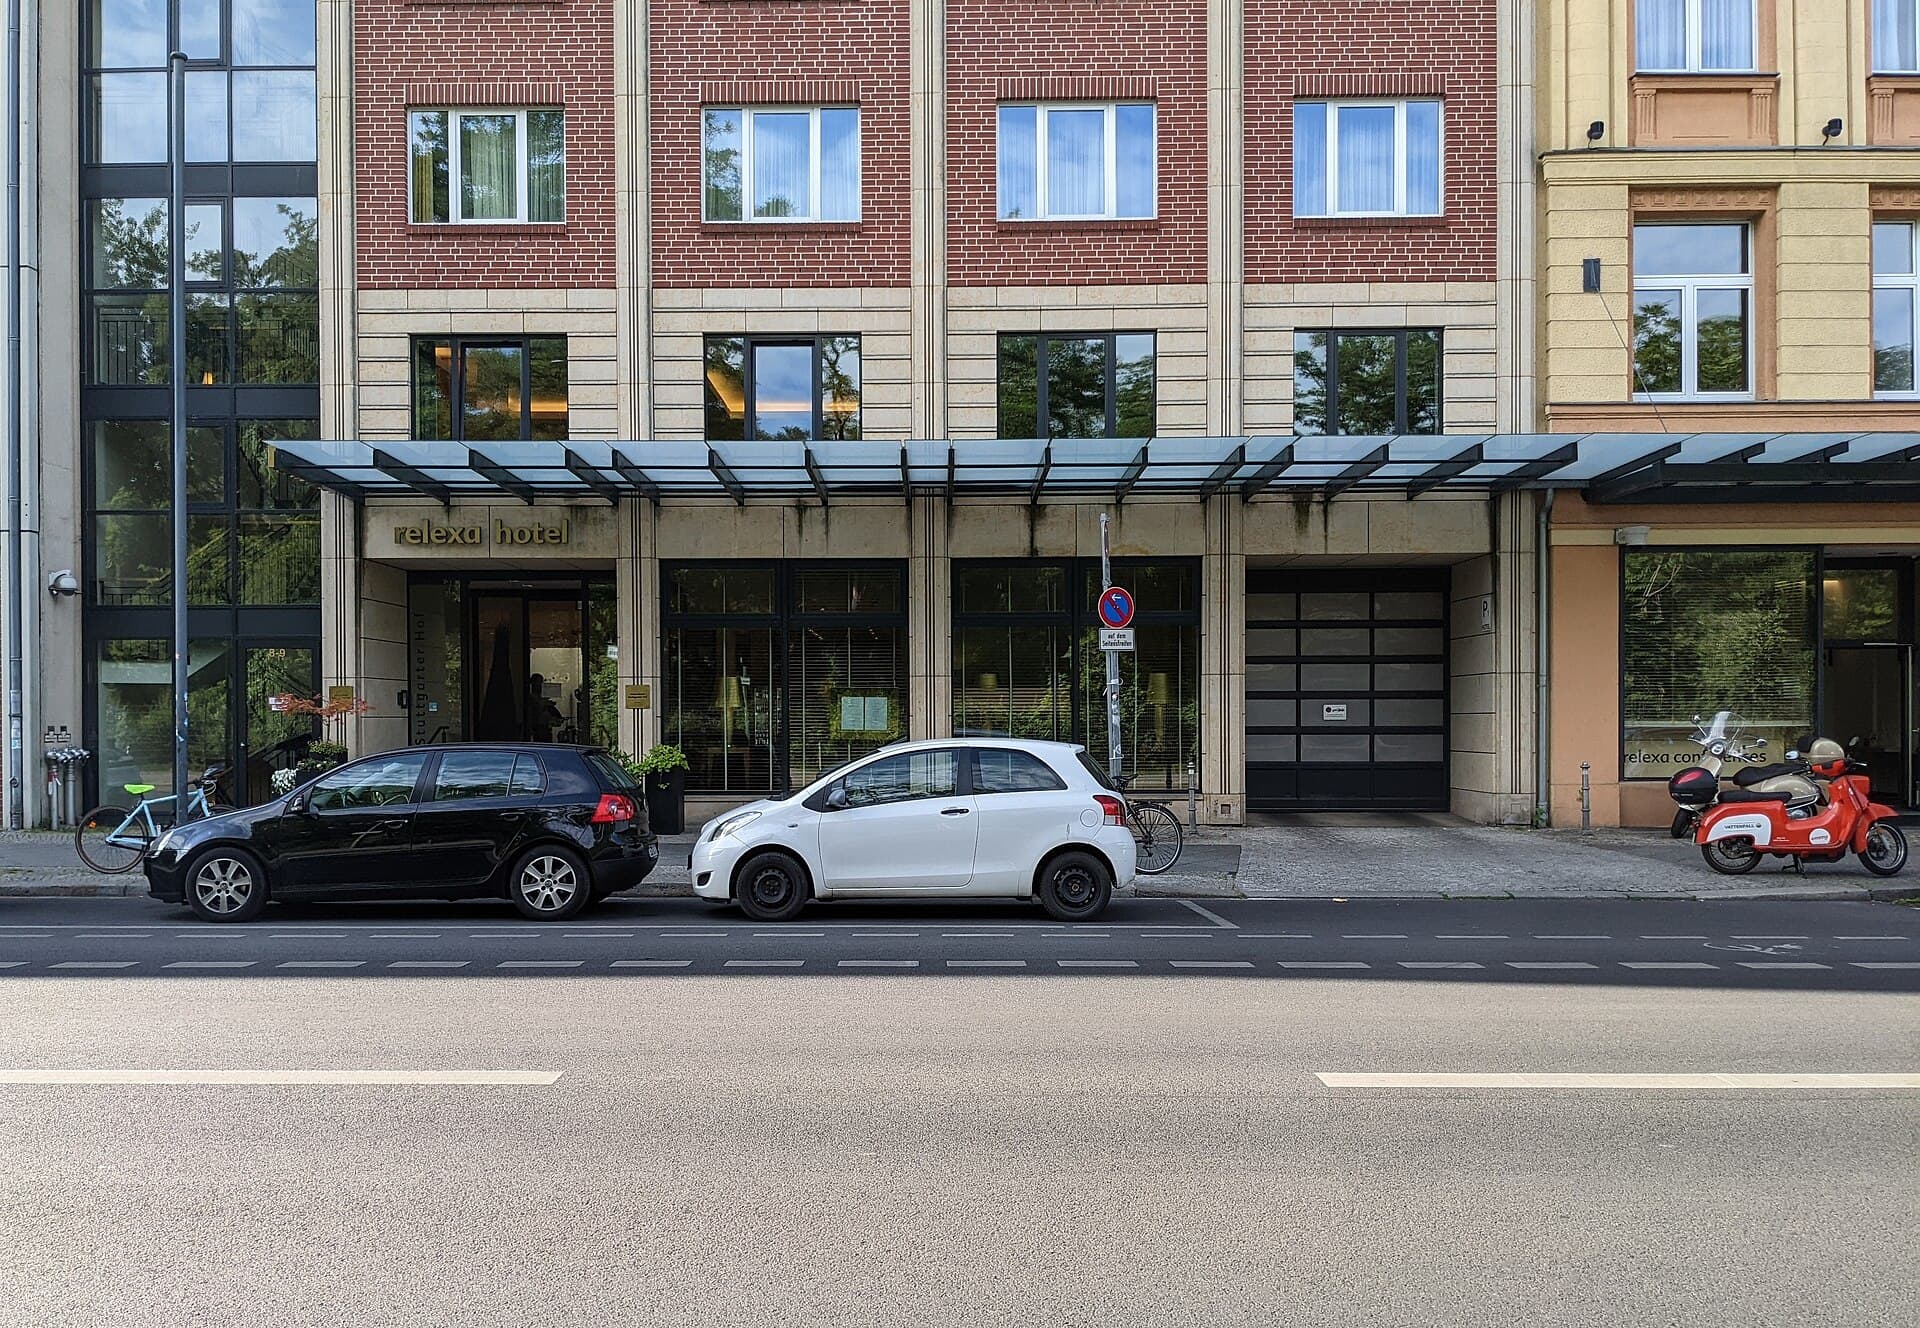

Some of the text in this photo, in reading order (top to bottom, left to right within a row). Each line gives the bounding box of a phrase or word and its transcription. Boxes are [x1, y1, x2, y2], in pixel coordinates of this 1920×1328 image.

[394, 518, 570, 545] relexa hotel
[269, 648, 286, 658] 8-9
[414, 611, 428, 746] Stuttgarter Hof
[1624, 748, 1767, 763] relexa confences
